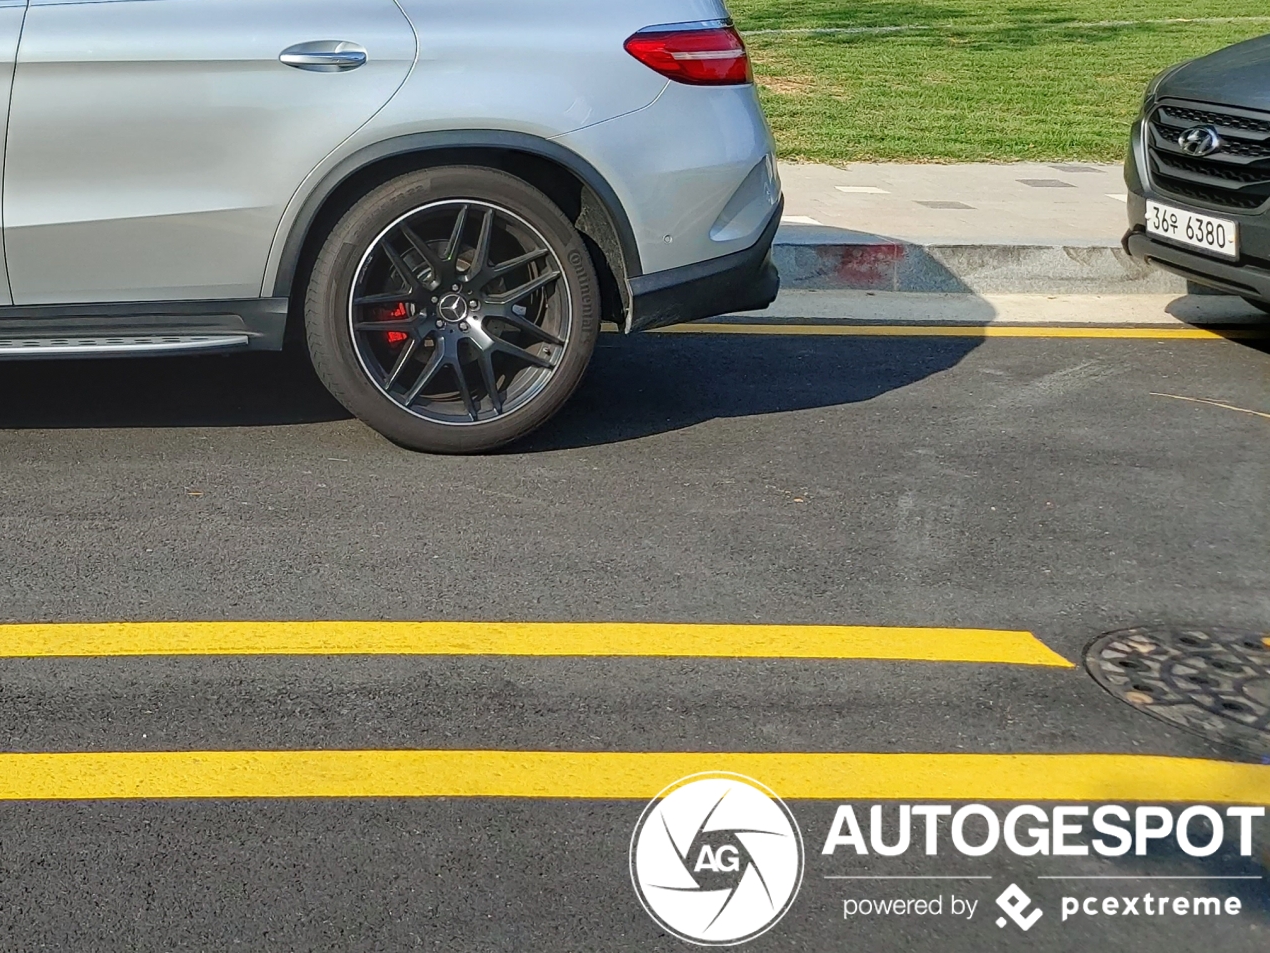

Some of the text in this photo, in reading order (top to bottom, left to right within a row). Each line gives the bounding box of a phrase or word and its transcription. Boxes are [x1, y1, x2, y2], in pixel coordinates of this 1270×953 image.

[1152, 206, 1226, 249] 36우 6380
[566, 249, 593, 333] Continental
